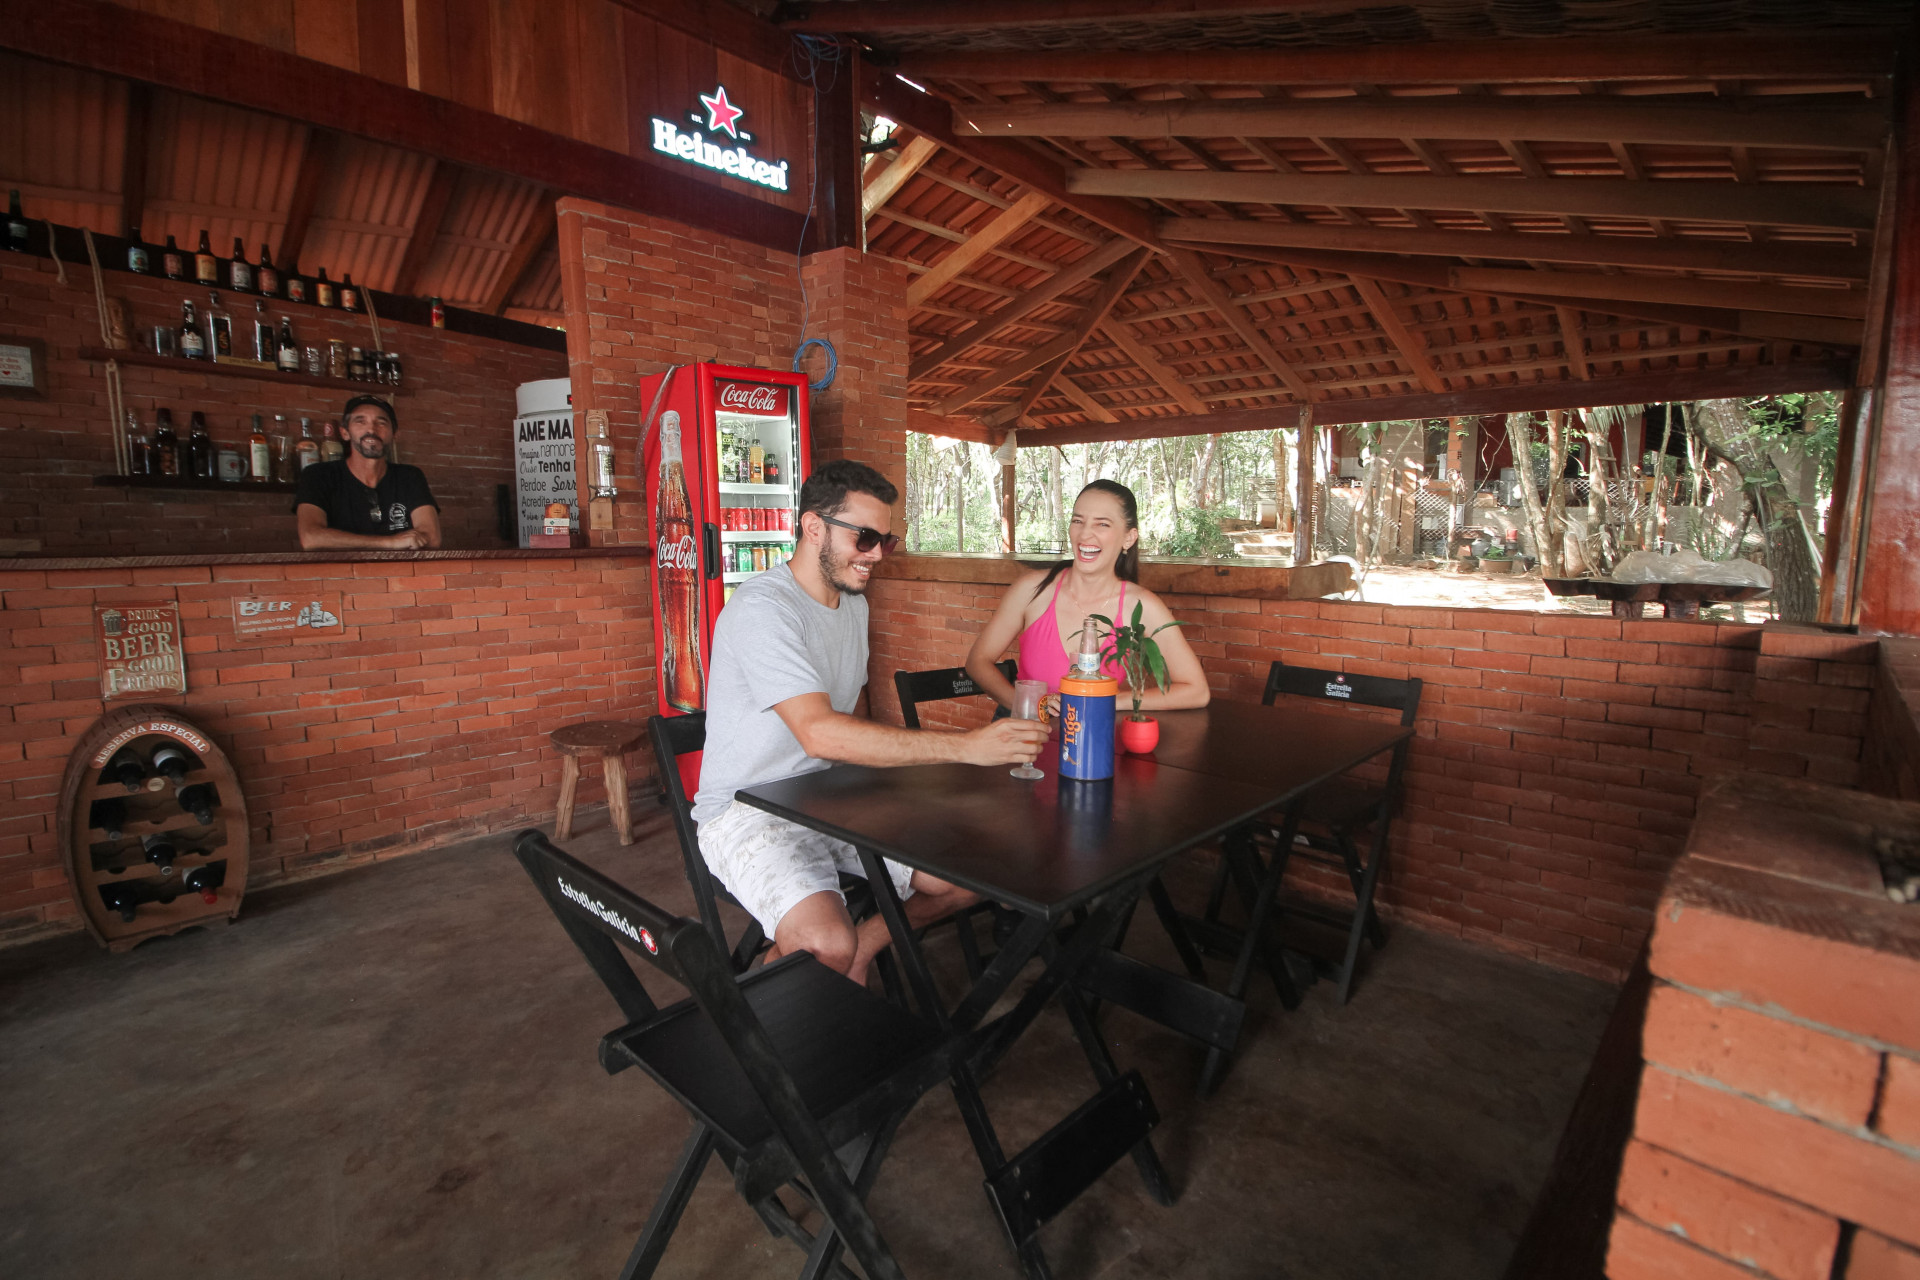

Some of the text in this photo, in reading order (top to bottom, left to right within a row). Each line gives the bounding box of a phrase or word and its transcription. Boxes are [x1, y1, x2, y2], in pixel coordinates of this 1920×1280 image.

[652, 118, 788, 190] Heineken
[721, 383, 779, 411] Coca-Cola
[519, 420, 546, 442] AME
[520, 461, 537, 474] Ouse
[538, 459, 571, 473] Tenha
[520, 477, 547, 492] Perdoe
[657, 534, 698, 570] Coca-Cola
[127, 609, 160, 621] DRINK
[238, 601, 293, 616] BEER
[128, 621, 173, 635] GOOD
[103, 632, 175, 660] BEER
[128, 654, 175, 673] GOOD
[108, 668, 180, 695] FRIENDS
[1325, 682, 1352, 692] Estrella
[1325, 690, 1350, 699] Galicia
[1064, 703, 1082, 745] Tiger
[96, 723, 206, 763] RESERVA ESPECIAL
